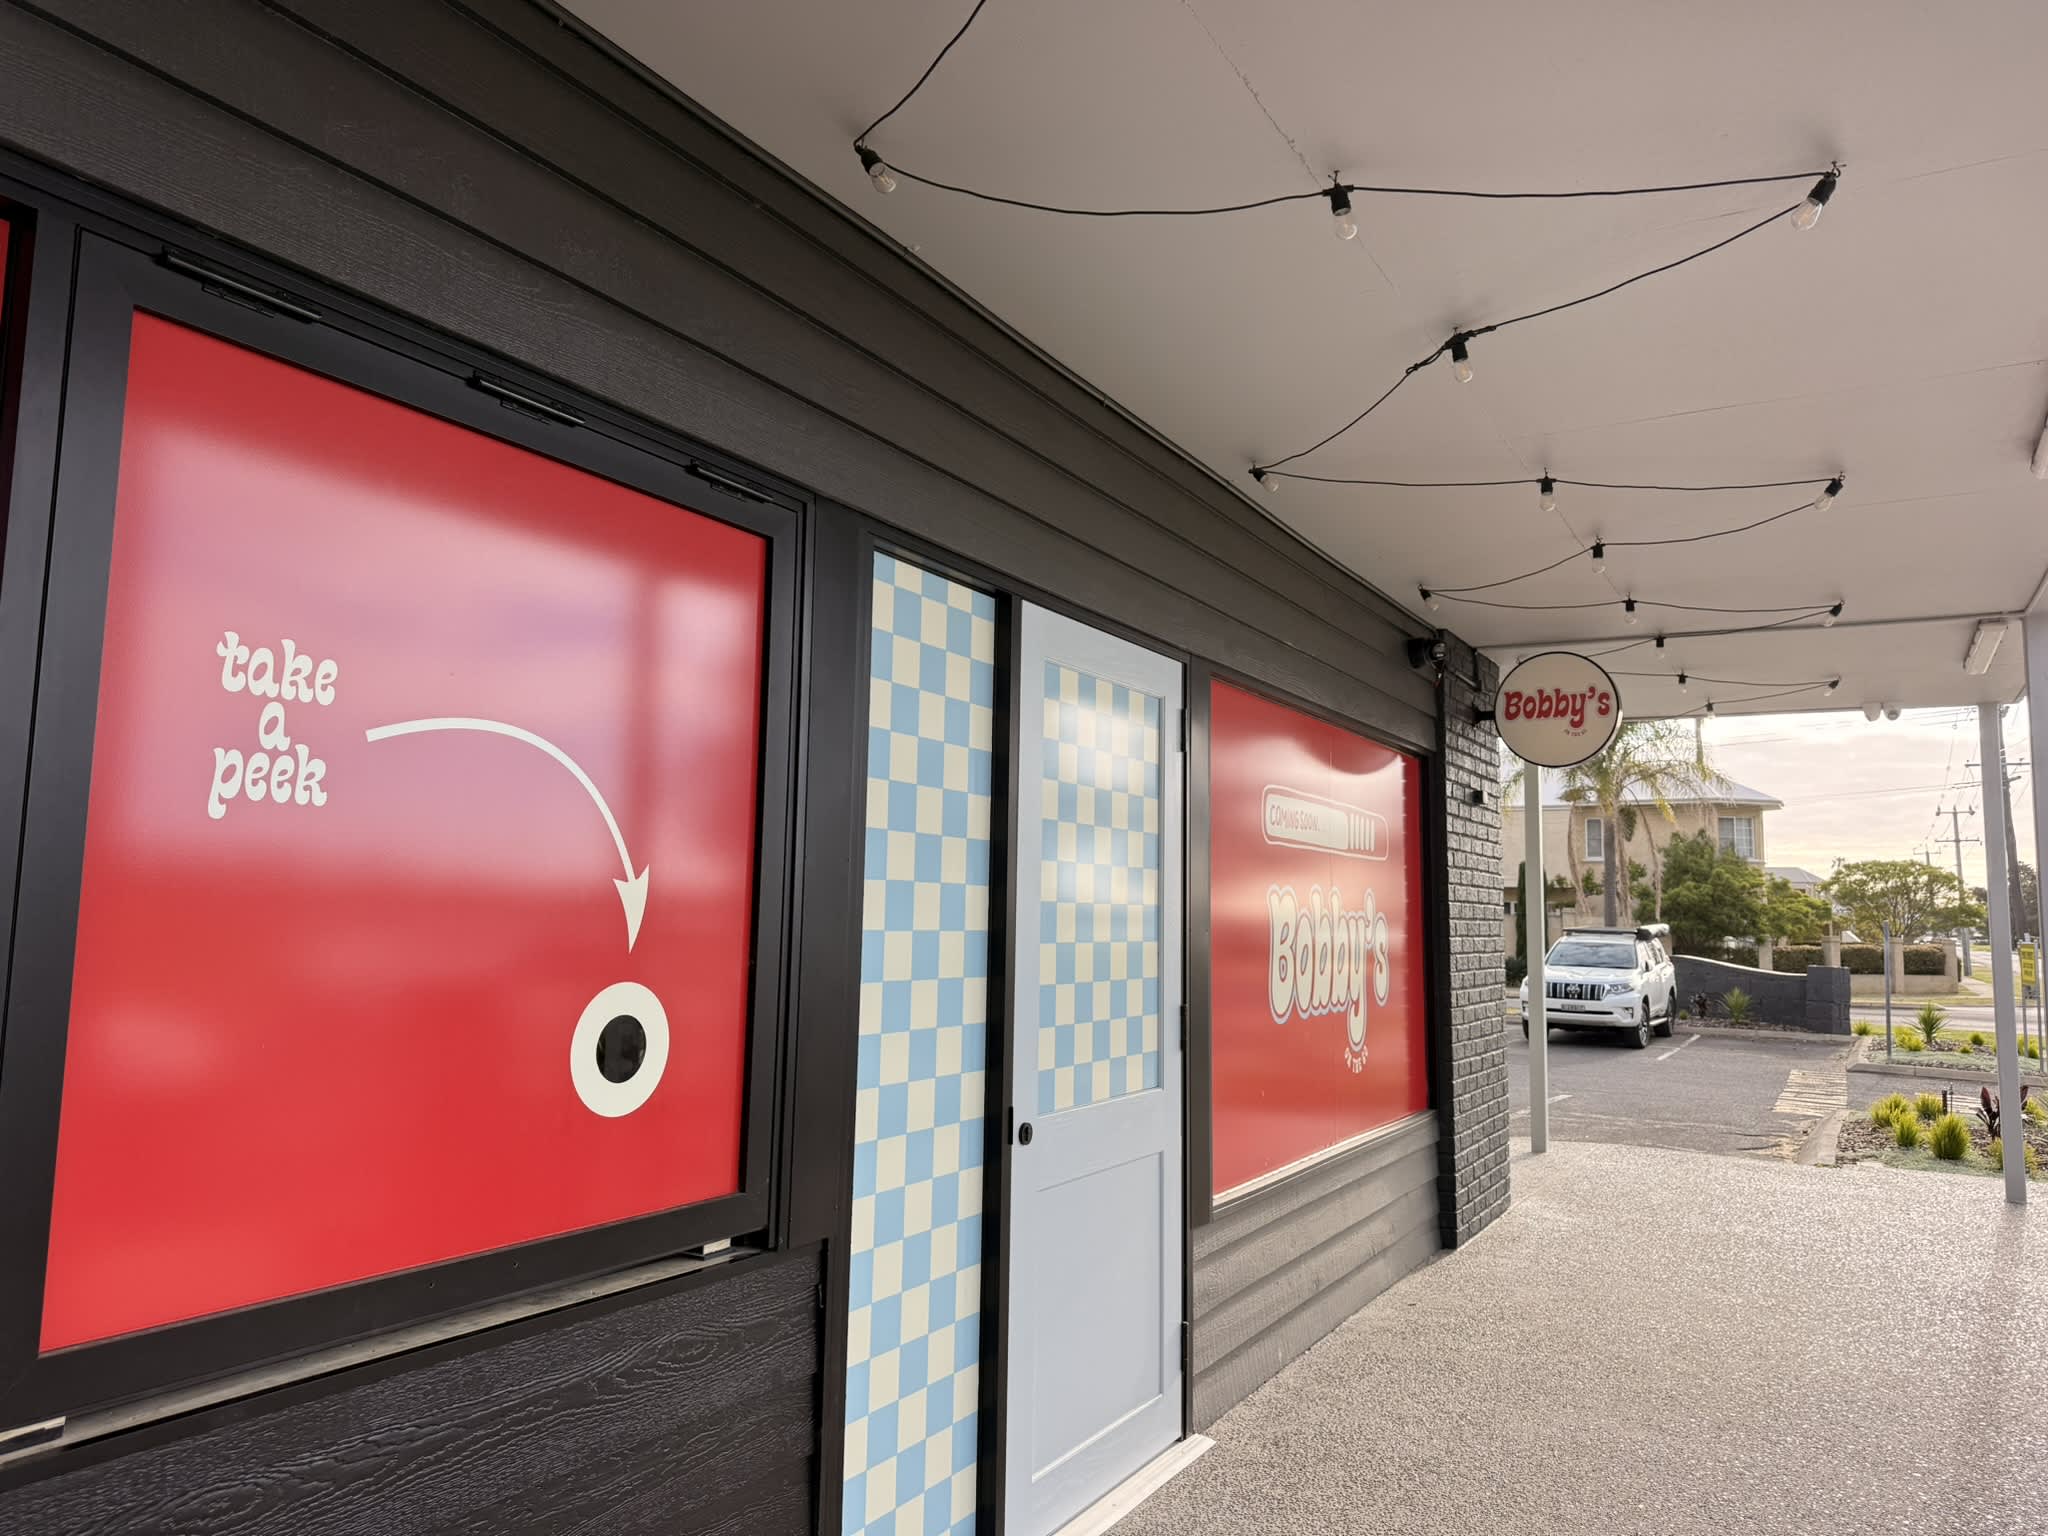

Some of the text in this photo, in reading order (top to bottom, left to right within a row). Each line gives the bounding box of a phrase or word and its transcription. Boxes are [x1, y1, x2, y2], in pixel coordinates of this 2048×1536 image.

[216, 631, 338, 706] take
[258, 701, 291, 751] a
[1504, 686, 1611, 729] Bobby's
[207, 744, 328, 819] peek
[1269, 804, 1299, 831] COMING
[1267, 884, 1389, 1051] Bobby's
